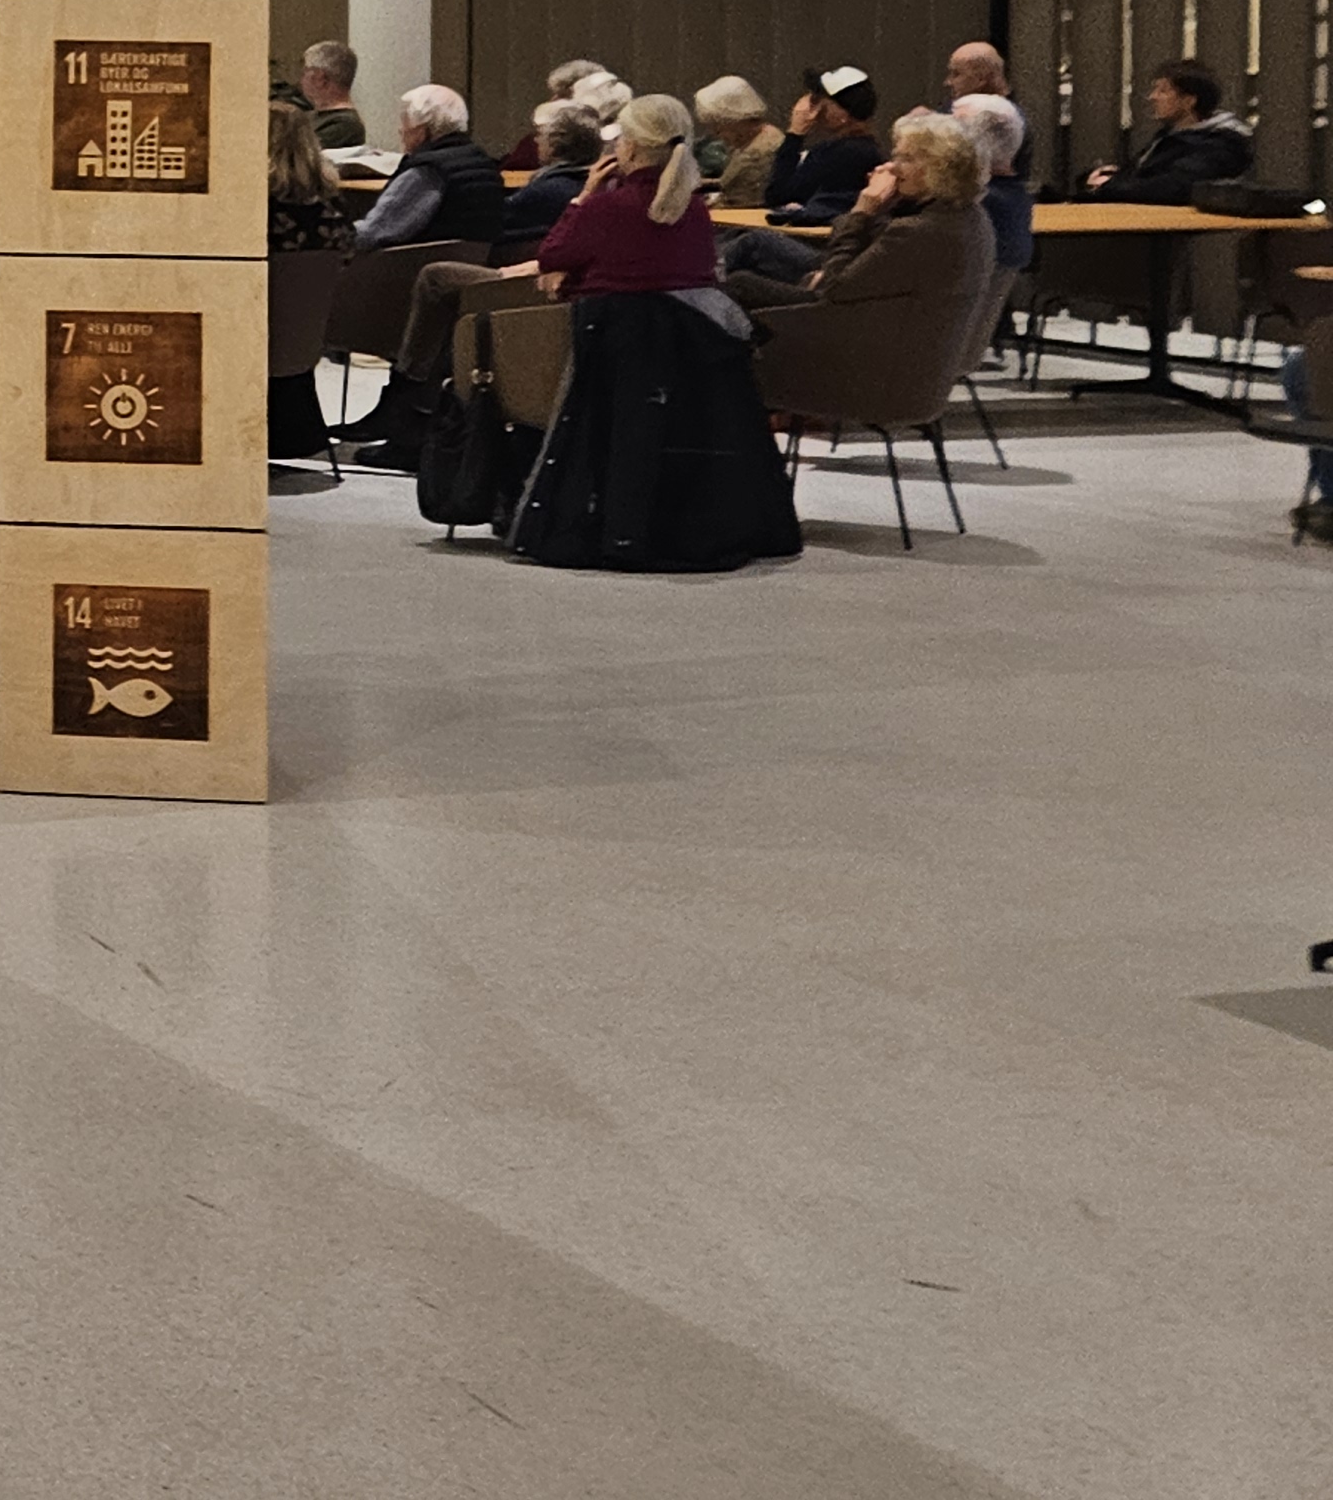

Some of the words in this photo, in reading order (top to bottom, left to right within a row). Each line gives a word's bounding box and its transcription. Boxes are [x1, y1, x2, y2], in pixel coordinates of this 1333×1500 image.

[64, 51, 88, 84] 11
[61, 322, 76, 354] 7
[64, 596, 92, 629] 14
